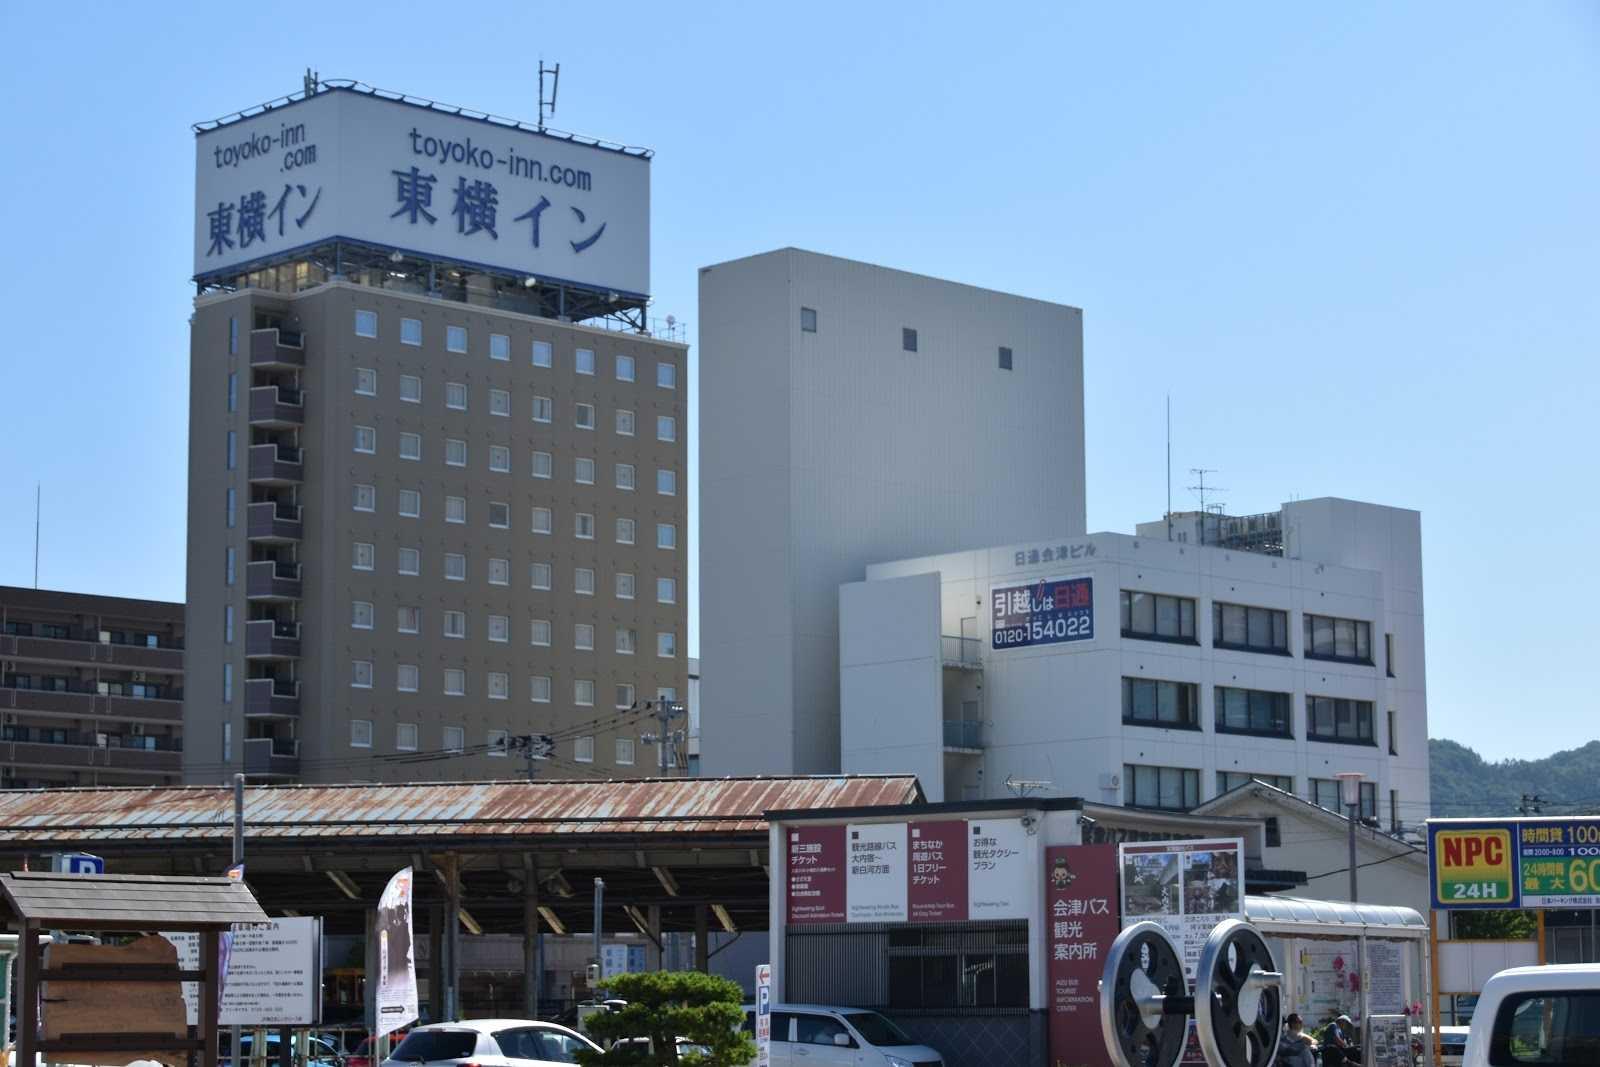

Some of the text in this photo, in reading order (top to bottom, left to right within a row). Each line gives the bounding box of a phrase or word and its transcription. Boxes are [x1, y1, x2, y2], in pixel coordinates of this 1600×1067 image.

[214, 122, 305, 169] toyoko-inn
[279, 143, 317, 173] .com
[408, 127, 592, 191] toyoko-inn.com
[391, 166, 607, 254] 東横イン
[206, 183, 322, 257] 東横イン
[995, 616, 1090, 644] 0120-154022
[1567, 826, 1600, 843] 100
[791, 855, 818, 865] チケット
[1443, 837, 1503, 867] NPC
[1567, 847, 1600, 856] 100
[912, 874, 941, 885] チケット
[1453, 882, 1498, 899] 24H
[1053, 899, 1110, 917] 会津バス
[1054, 922, 1083, 939] 観光
[1054, 942, 1097, 961] 案内所
